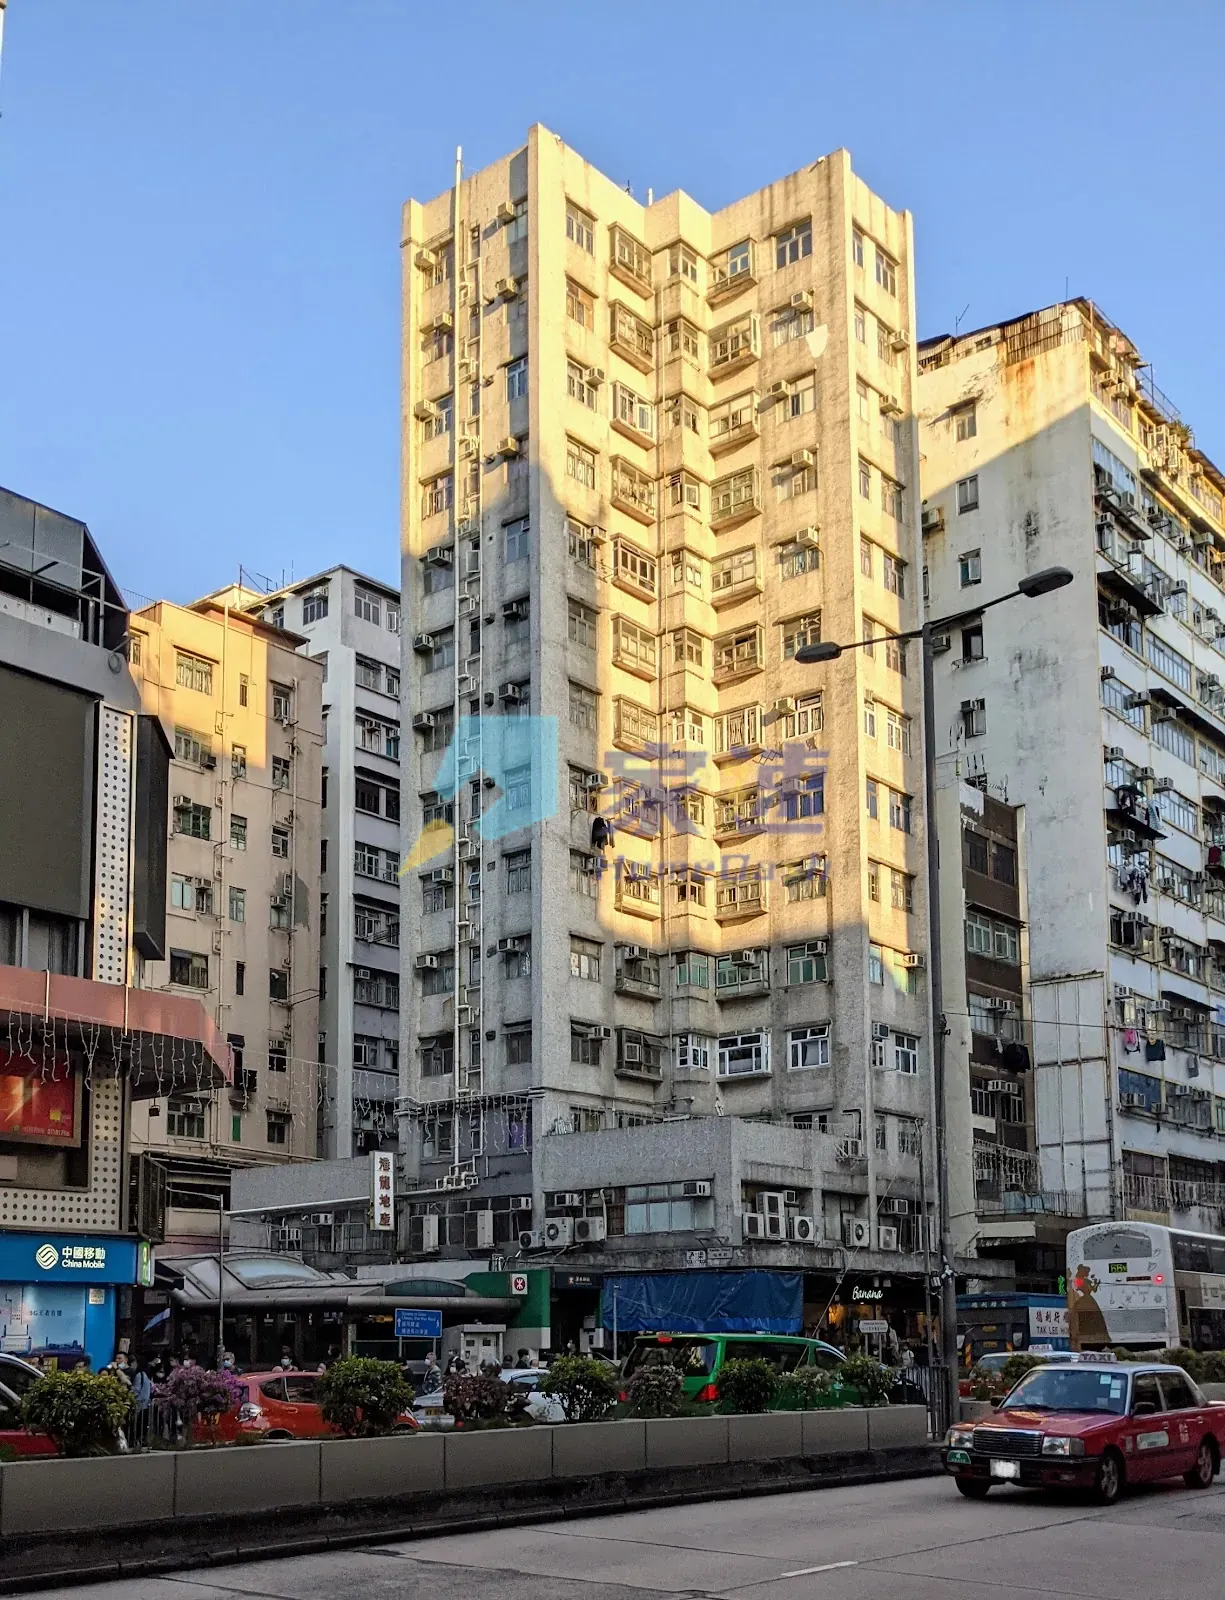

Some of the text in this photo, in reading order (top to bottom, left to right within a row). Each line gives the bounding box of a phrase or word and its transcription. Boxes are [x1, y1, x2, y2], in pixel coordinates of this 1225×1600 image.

[379, 1157, 391, 1226] 港龍地產
[61, 1246, 106, 1260] 中國移動
[61, 1259, 105, 1269] China Mobile
[852, 1286, 883, 1300] Banana
[1037, 1326, 1047, 1334] TAK
[1049, 1327, 1058, 1335] LEE
[1082, 1353, 1111, 1362] TAXI
